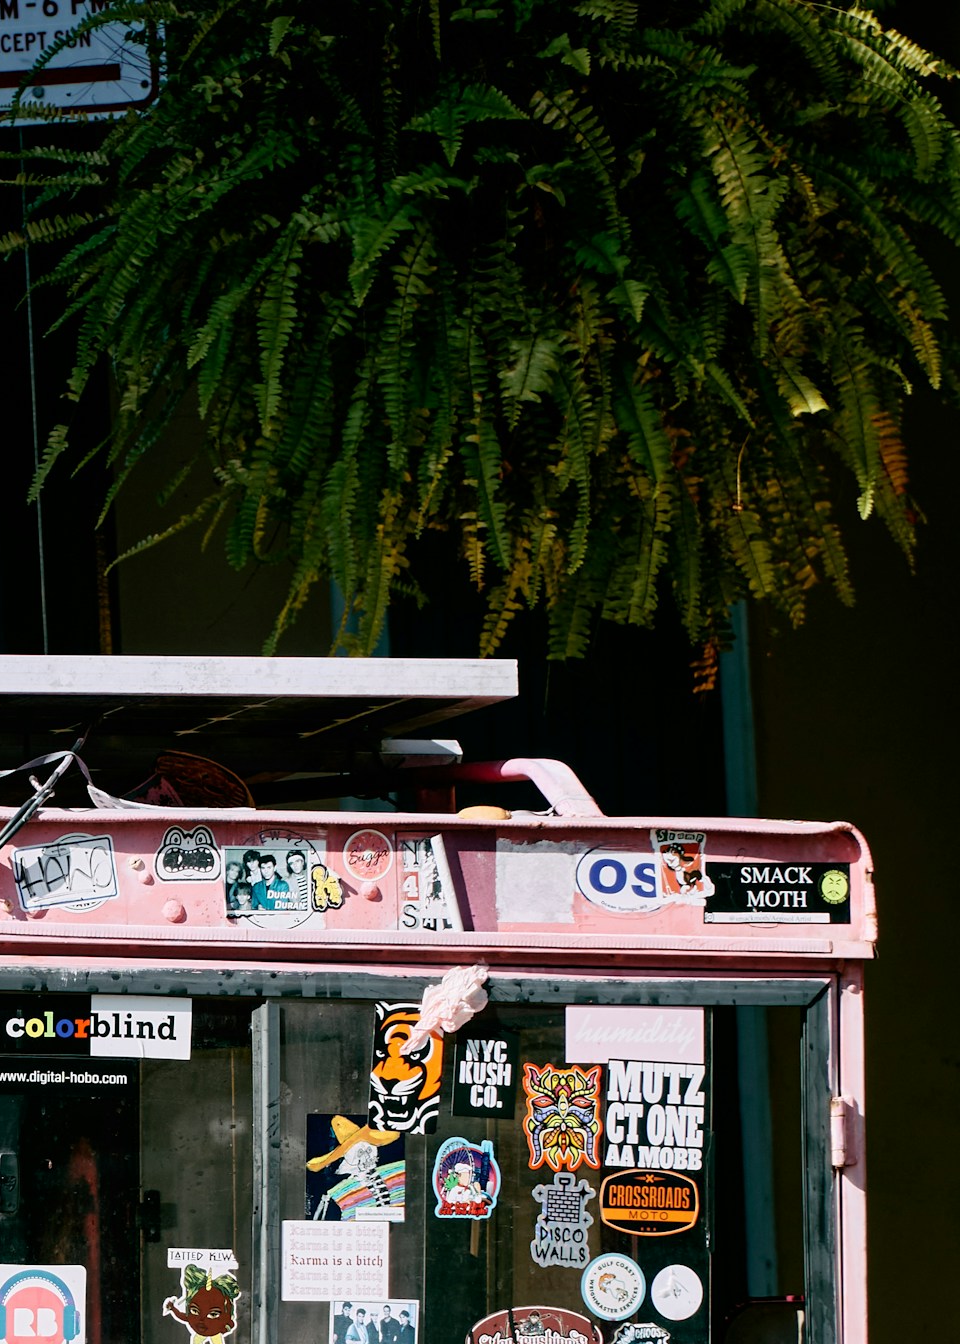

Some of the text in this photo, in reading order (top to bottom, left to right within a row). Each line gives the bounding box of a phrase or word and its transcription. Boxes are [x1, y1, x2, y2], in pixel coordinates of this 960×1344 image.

[589, 858, 657, 898] OS
[740, 866, 813, 884] SMACK
[267, 889, 298, 899] DURAN
[746, 890, 807, 908] MOTH
[576, 1014, 696, 1053] humidity
[465, 1039, 508, 1063] NYC
[459, 1061, 511, 1087] KUSH
[607, 1060, 705, 1106] MUTZ
[470, 1085, 503, 1109] CO.
[606, 1102, 704, 1148] CT ONE
[605, 1145, 703, 1170] AA MOBB
[609, 1184, 690, 1209] CROSSROADS
[629, 1211, 669, 1220] MOTO
[540, 1225, 584, 1247] DISCO
[169, 1250, 237, 1262] TATTED KIW
[332, 1256, 342, 1266] is
[346, 1258, 352, 1266] a
[355, 1254, 384, 1268] bitch
[535, 1245, 586, 1263] WALLS
[597, 1261, 635, 1277] GULF COAST
[589, 1279, 638, 1313] WEIGHMASTER SERVICES
[13, 1307, 58, 1337] RB
